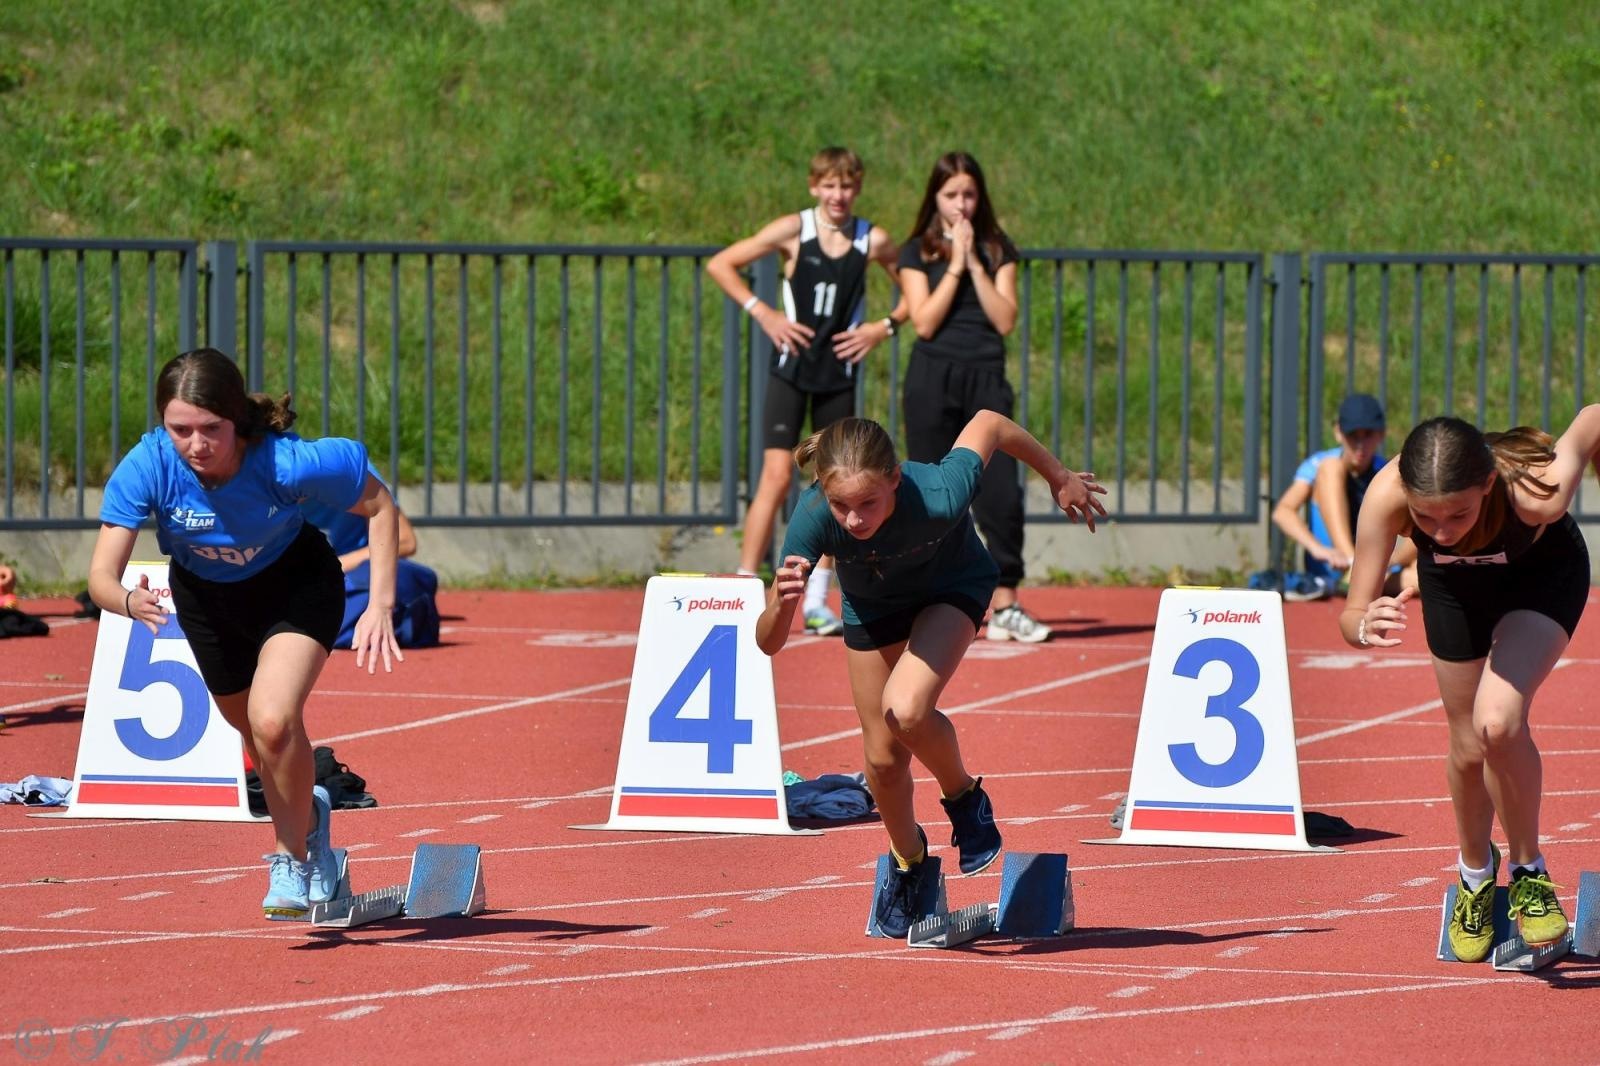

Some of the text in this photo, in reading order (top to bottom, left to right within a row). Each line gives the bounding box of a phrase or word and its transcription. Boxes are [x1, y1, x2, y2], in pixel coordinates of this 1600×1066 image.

[813, 281, 837, 317] 11
[185, 518, 215, 528] TEAM
[687, 597, 745, 613] polanik
[1203, 609, 1262, 625] polanik
[113, 613, 211, 762] 5
[648, 624, 753, 774] 4
[1167, 637, 1265, 789] 3
